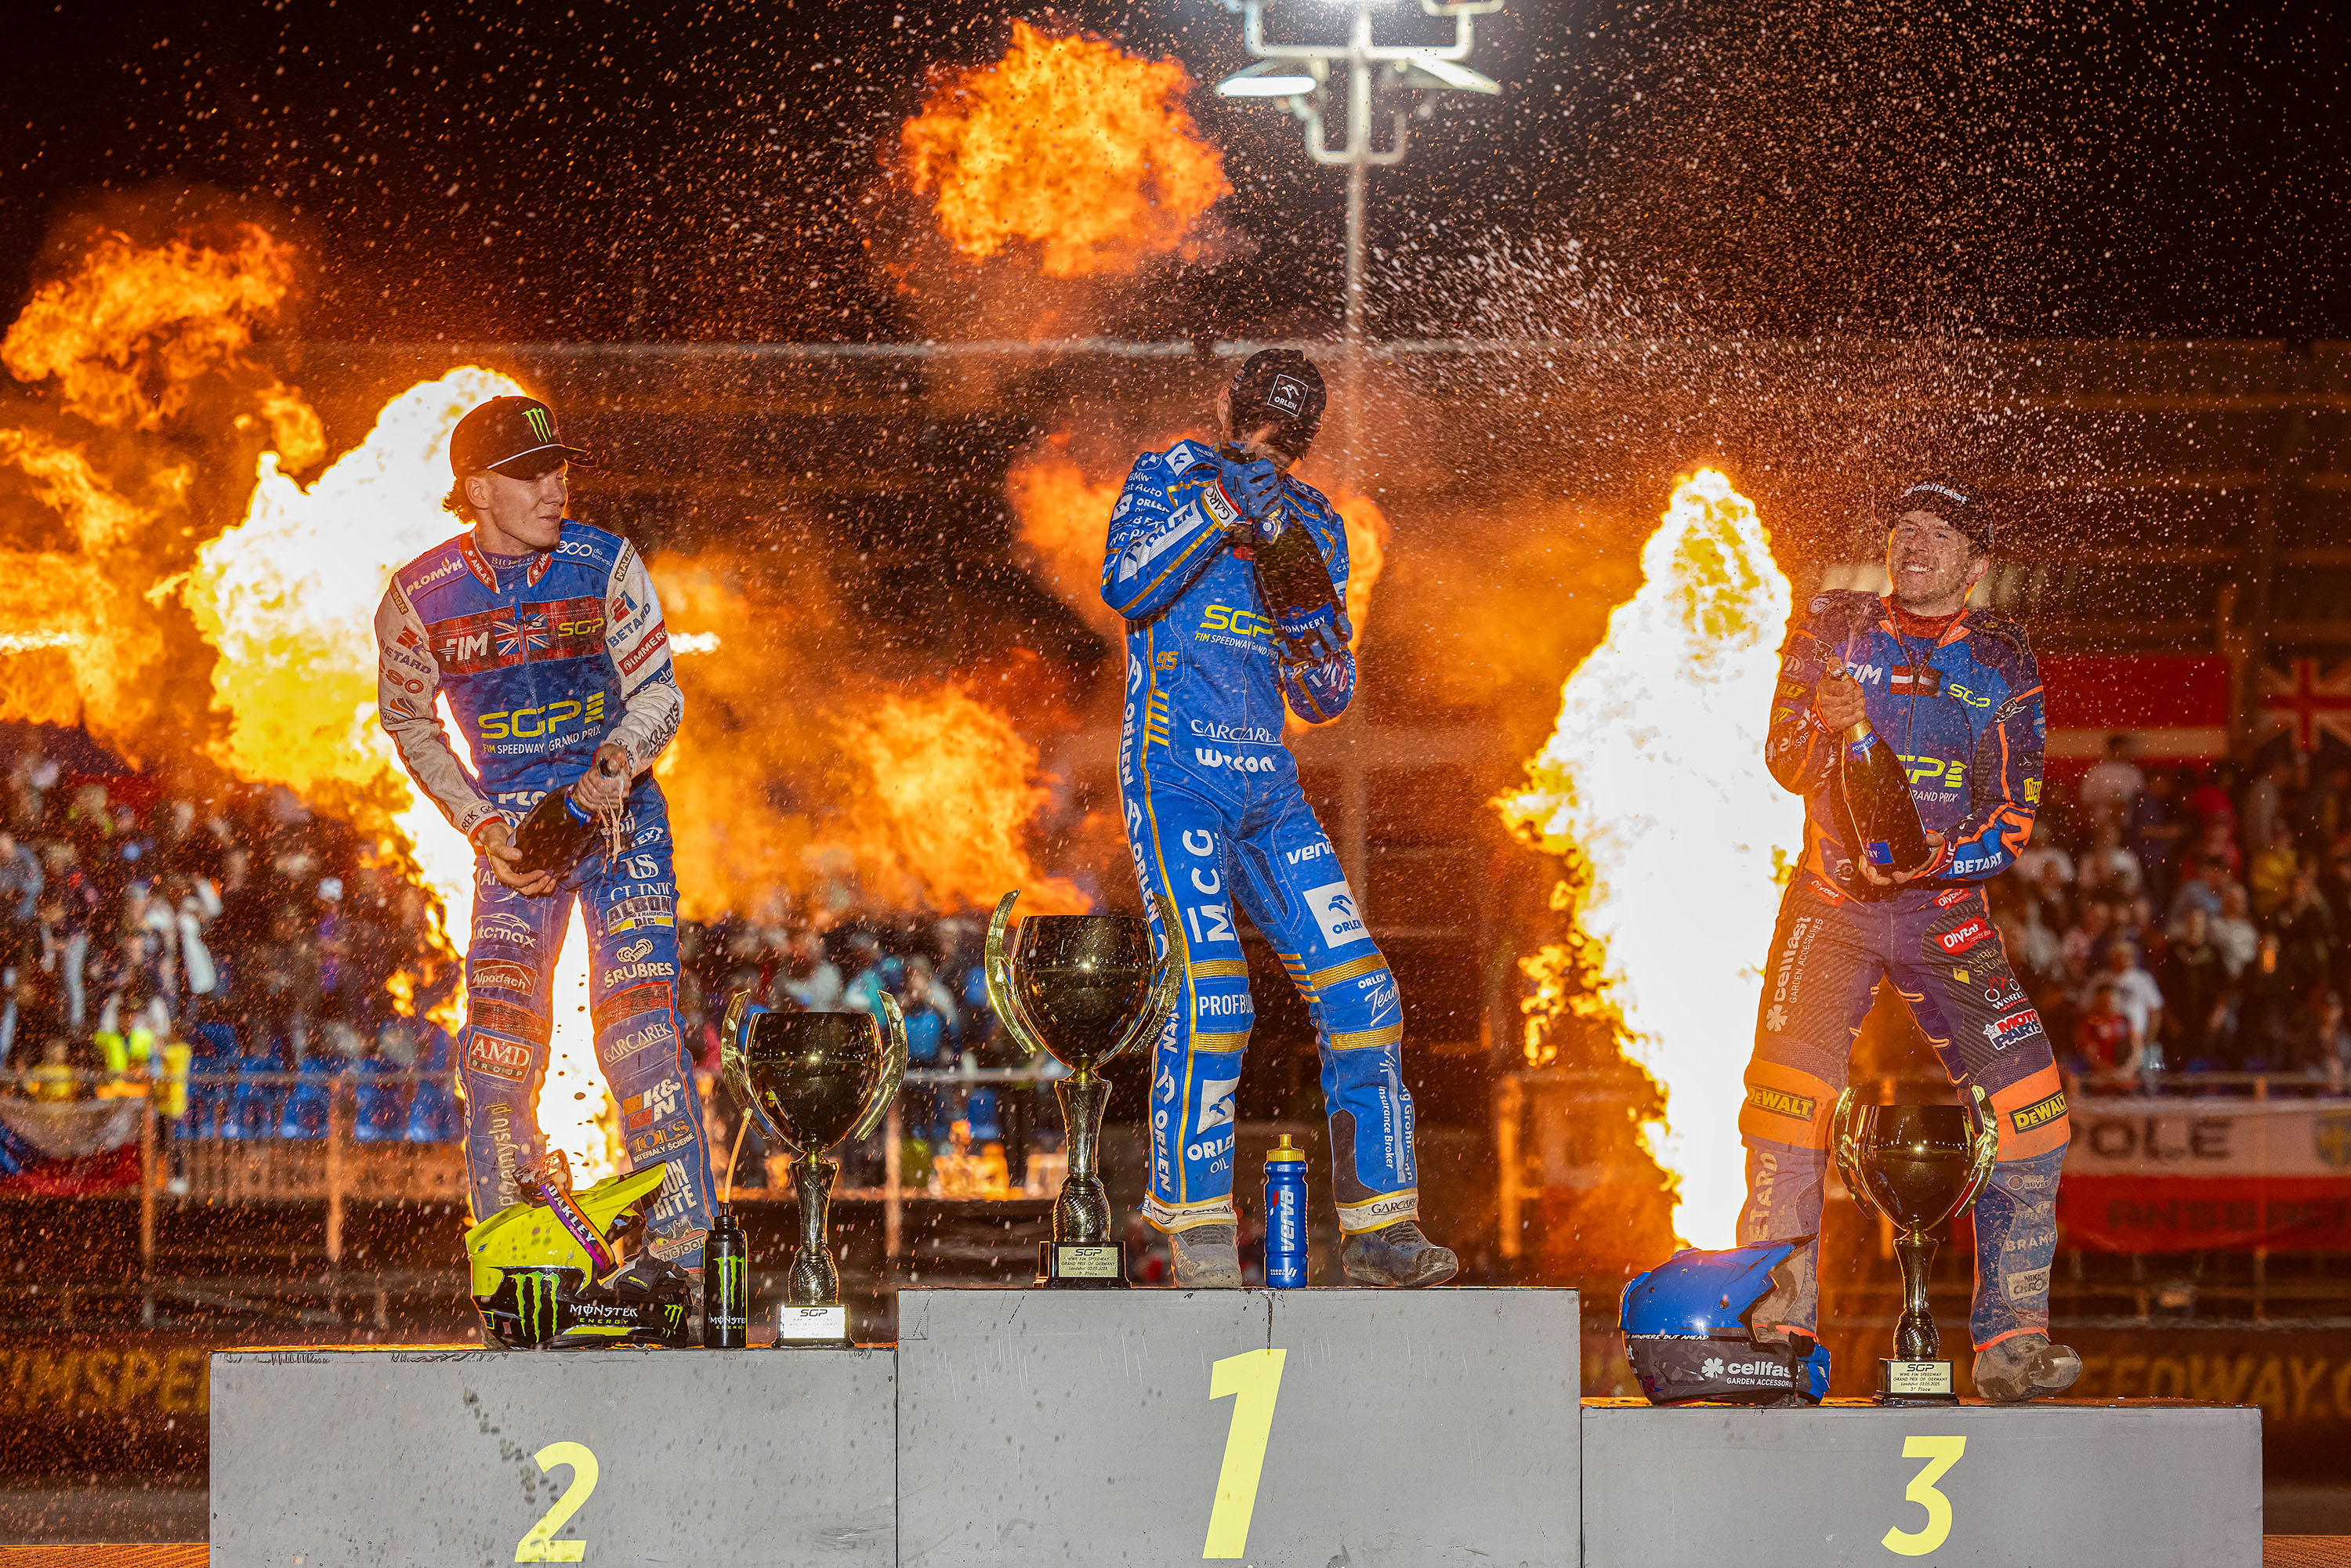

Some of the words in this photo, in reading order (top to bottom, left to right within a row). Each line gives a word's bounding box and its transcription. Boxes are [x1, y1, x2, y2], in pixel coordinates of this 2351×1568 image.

[1274, 397, 1297, 411] ORLEN
[1135, 483, 1162, 497] Auto
[470, 558, 492, 585] ANLAS
[592, 553, 614, 567] biznesu
[557, 617, 605, 637] SGP
[1195, 632, 1211, 643] FIM
[437, 632, 489, 662] FIM
[1156, 651, 1179, 671] 95
[477, 699, 582, 740] SGP
[483, 744, 495, 755] FIM
[497, 744, 545, 754] SPEEDWAY
[548, 732, 580, 751] GRAND
[581, 724, 601, 740] PRIX
[1122, 702, 1135, 788] ORLEN
[1939, 791, 1958, 802] PRIX
[1133, 842, 1161, 922] ORLEN
[473, 972, 526, 990] Alpodach
[603, 961, 675, 990] ŚRUBRES
[1358, 972, 1386, 990] ORLEN
[1789, 967, 1804, 1004] GARDEN
[603, 1022, 674, 1063] GARCAREK
[1991, 1020, 2041, 1049] PARTS
[472, 1037, 531, 1067] AMD
[1378, 1085, 1392, 1134] Insurance
[1155, 1109, 1172, 1193] ORLEN
[1384, 1134, 1394, 1169] Broker
[1210, 1157, 1230, 1175] OIL
[549, 1184, 596, 1243] OAKLEY
[652, 1183, 697, 1222] BITE
[800, 1309, 828, 1317] SGP
[1726, 1377, 1755, 1386] GARDEN
[1907, 1363, 1935, 1372] SGP
[1203, 1348, 1288, 1559] 1
[513, 1440, 600, 1563] 2
[1881, 1435, 1968, 1557] 3
